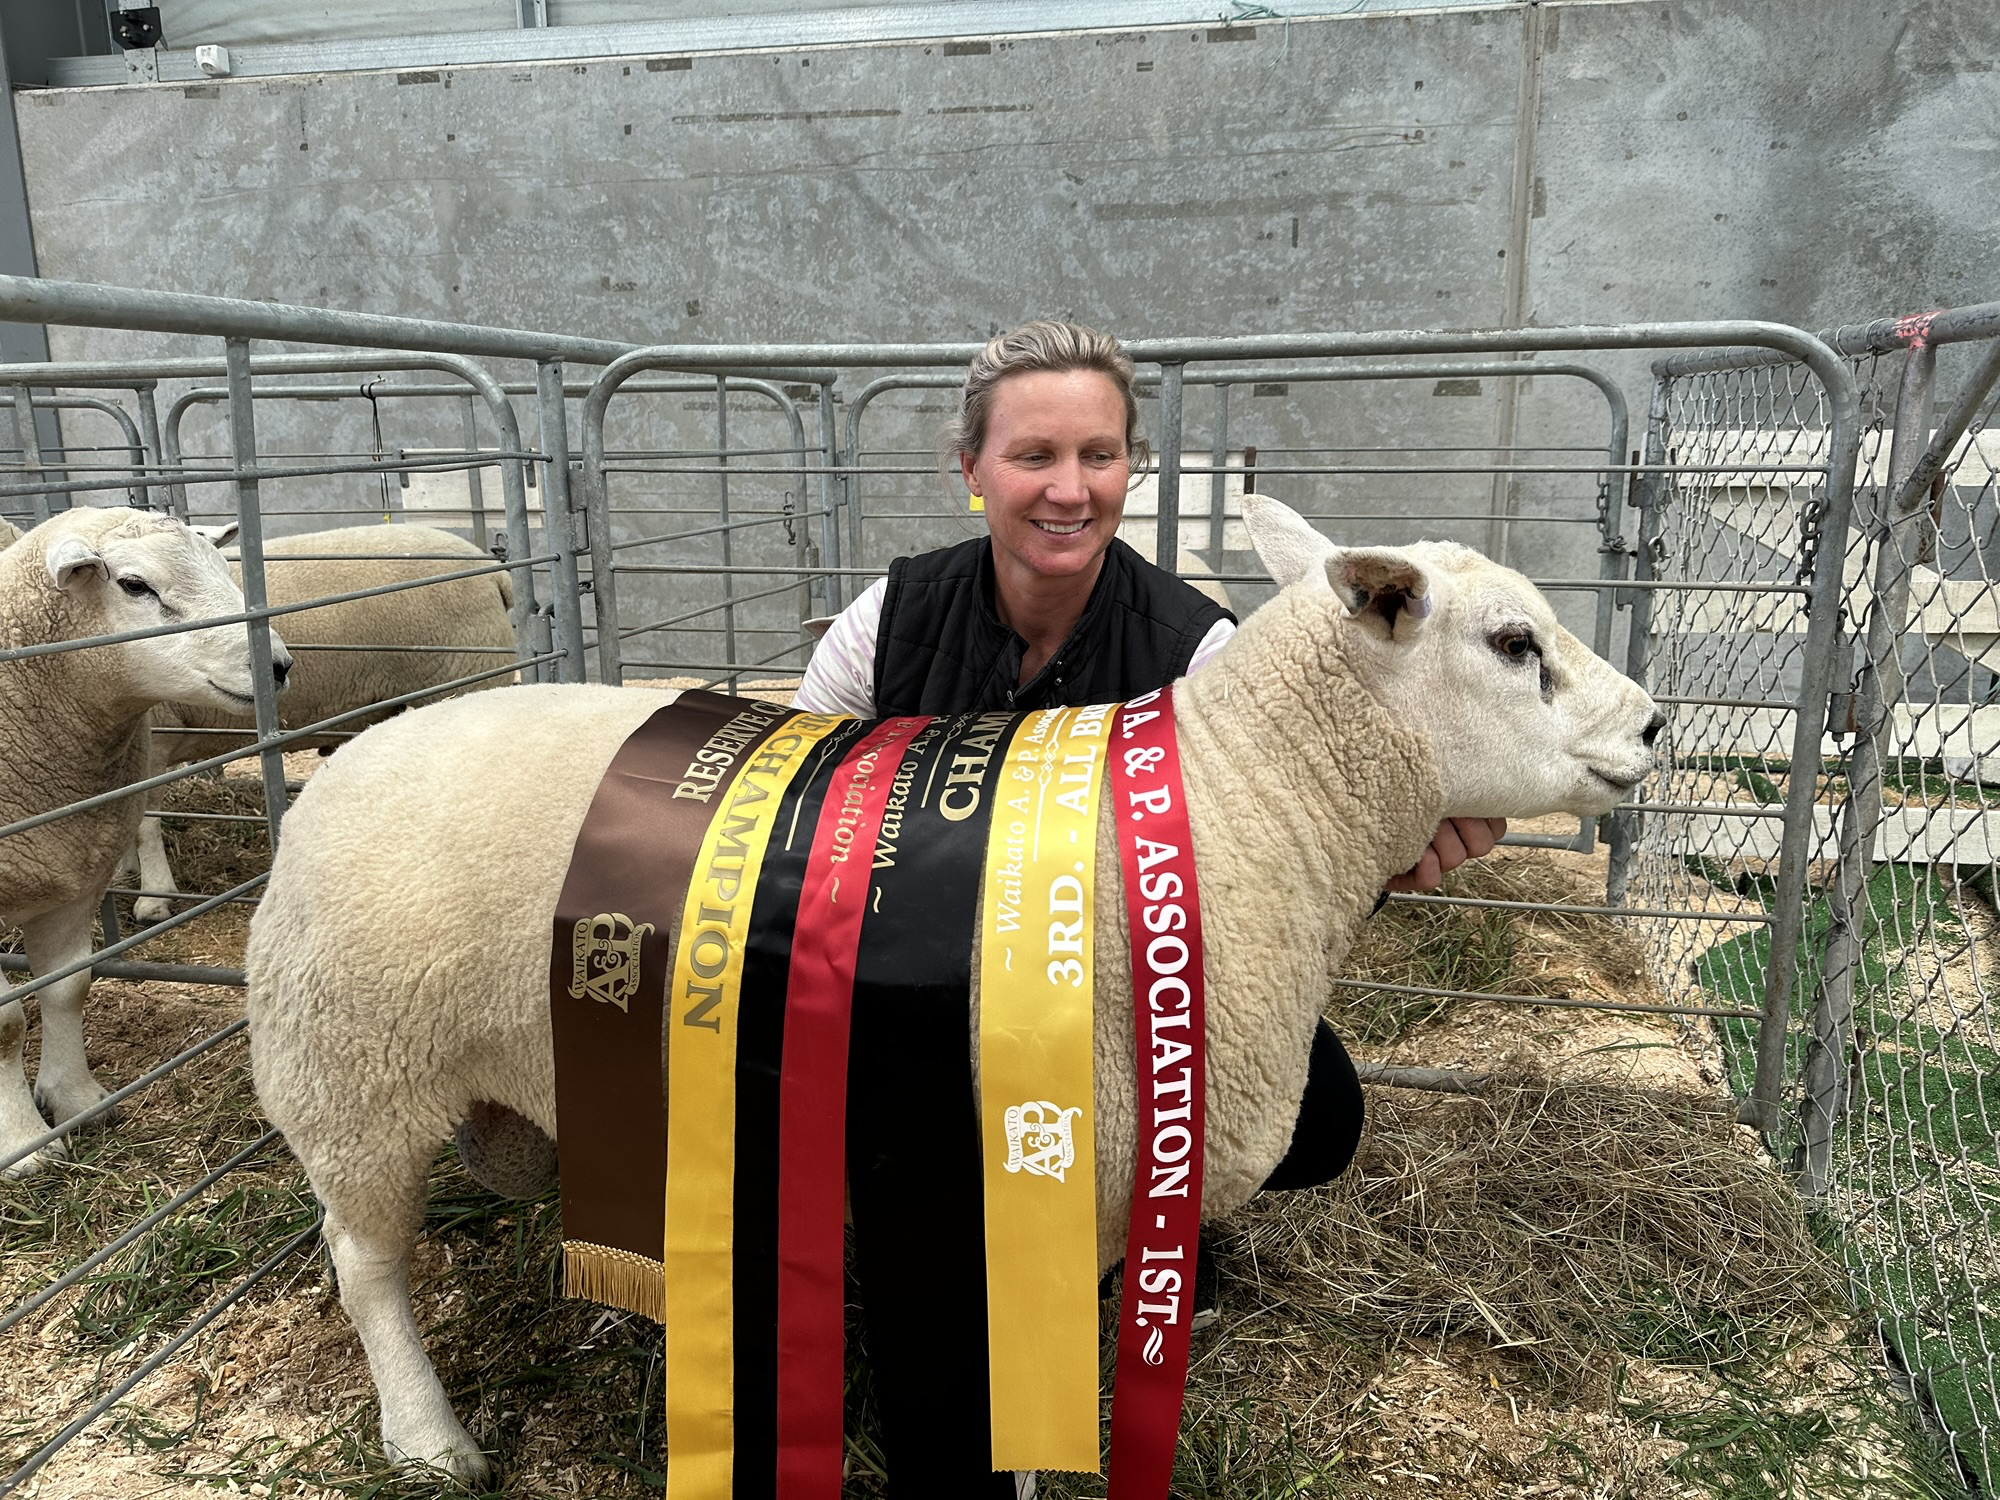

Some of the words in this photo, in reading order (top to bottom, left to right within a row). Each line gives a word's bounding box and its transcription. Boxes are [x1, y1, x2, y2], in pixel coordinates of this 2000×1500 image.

[672, 711, 775, 804] RESERVE
[1017, 748, 1040, 763] P.
[1122, 710, 1161, 739] A.
[1012, 766, 1035, 782] &
[1056, 745, 1098, 816] ALL
[1123, 746, 1166, 778] &
[872, 761, 919, 869] Waikato
[1007, 790, 1030, 814] A.
[1129, 784, 1172, 821] P.
[683, 734, 802, 1034] CHAMPION
[997, 821, 1026, 934] Waikato
[575, 922, 589, 991] WAIKATO
[1047, 861, 1085, 988] 3RD.
[631, 930, 642, 990] ASSOCIATION
[1135, 836, 1193, 1199] ASSOCIATION
[1007, 1109, 1020, 1166] WAIKATO
[1136, 1245, 1184, 1327] 1ST.
